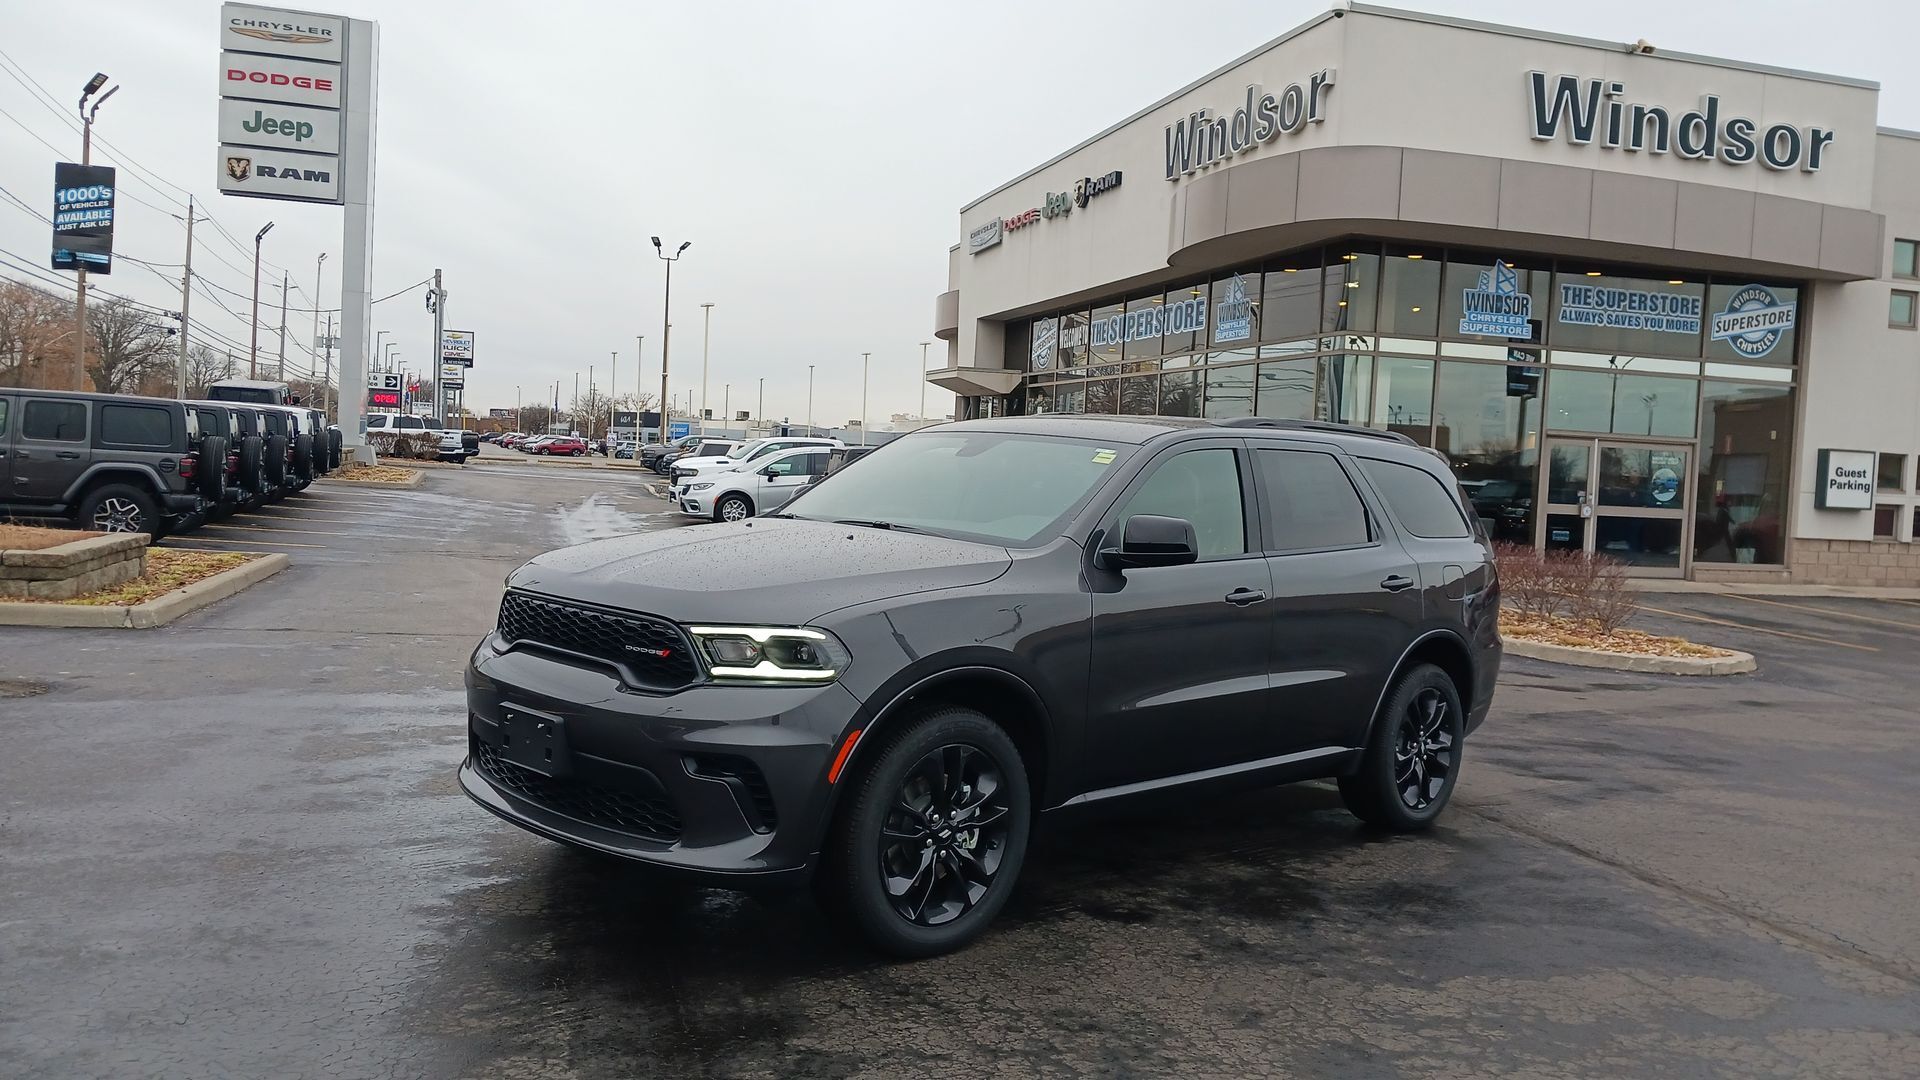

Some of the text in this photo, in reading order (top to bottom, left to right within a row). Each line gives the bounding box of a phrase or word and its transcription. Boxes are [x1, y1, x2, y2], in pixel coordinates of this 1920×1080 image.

[230, 18, 332, 36] CHRYSLER
[227, 69, 333, 91] DODGE
[242, 110, 313, 142] Jeep
[1165, 68, 1336, 181] Windsor
[1525, 69, 1835, 173] Windsor
[256, 165, 330, 183] RAM
[1085, 170, 1123, 197] RAM
[57, 186, 112, 203] 1000's
[59, 200, 109, 211] OF VEHICLES
[1041, 191, 1073, 219] Jeep
[57, 209, 112, 223] AVAILABLE
[1003, 208, 1038, 232] DODGE
[56, 222, 77, 231] JUST
[79, 221, 97, 229] ASK
[970, 221, 998, 239] CHRYSLER
[1465, 292, 1529, 316] WINDSOR
[1562, 286, 1700, 316] THE SUPERSTORE
[1732, 289, 1771, 309] WINDSOR
[1218, 300, 1250, 323] WINDSOR
[1470, 313, 1523, 325] CHRYSLER
[1561, 309, 1699, 332] ALWAYS SAVES YOU MORE!
[1092, 300, 1205, 345] THE SUPERSTORE
[1220, 320, 1247, 331] CHRYSLER
[1462, 322, 1529, 336] SUPERSTORE
[1715, 310, 1792, 333] SUPERSTORE
[1216, 329, 1250, 340] SUPERSTORE
[1736, 332, 1775, 353] CHRYSLER
[373, 393, 398, 404] OPEN
[1835, 466, 1867, 479] Guest
[1829, 478, 1871, 494] Parking
[625, 644, 664, 656] DODGE
